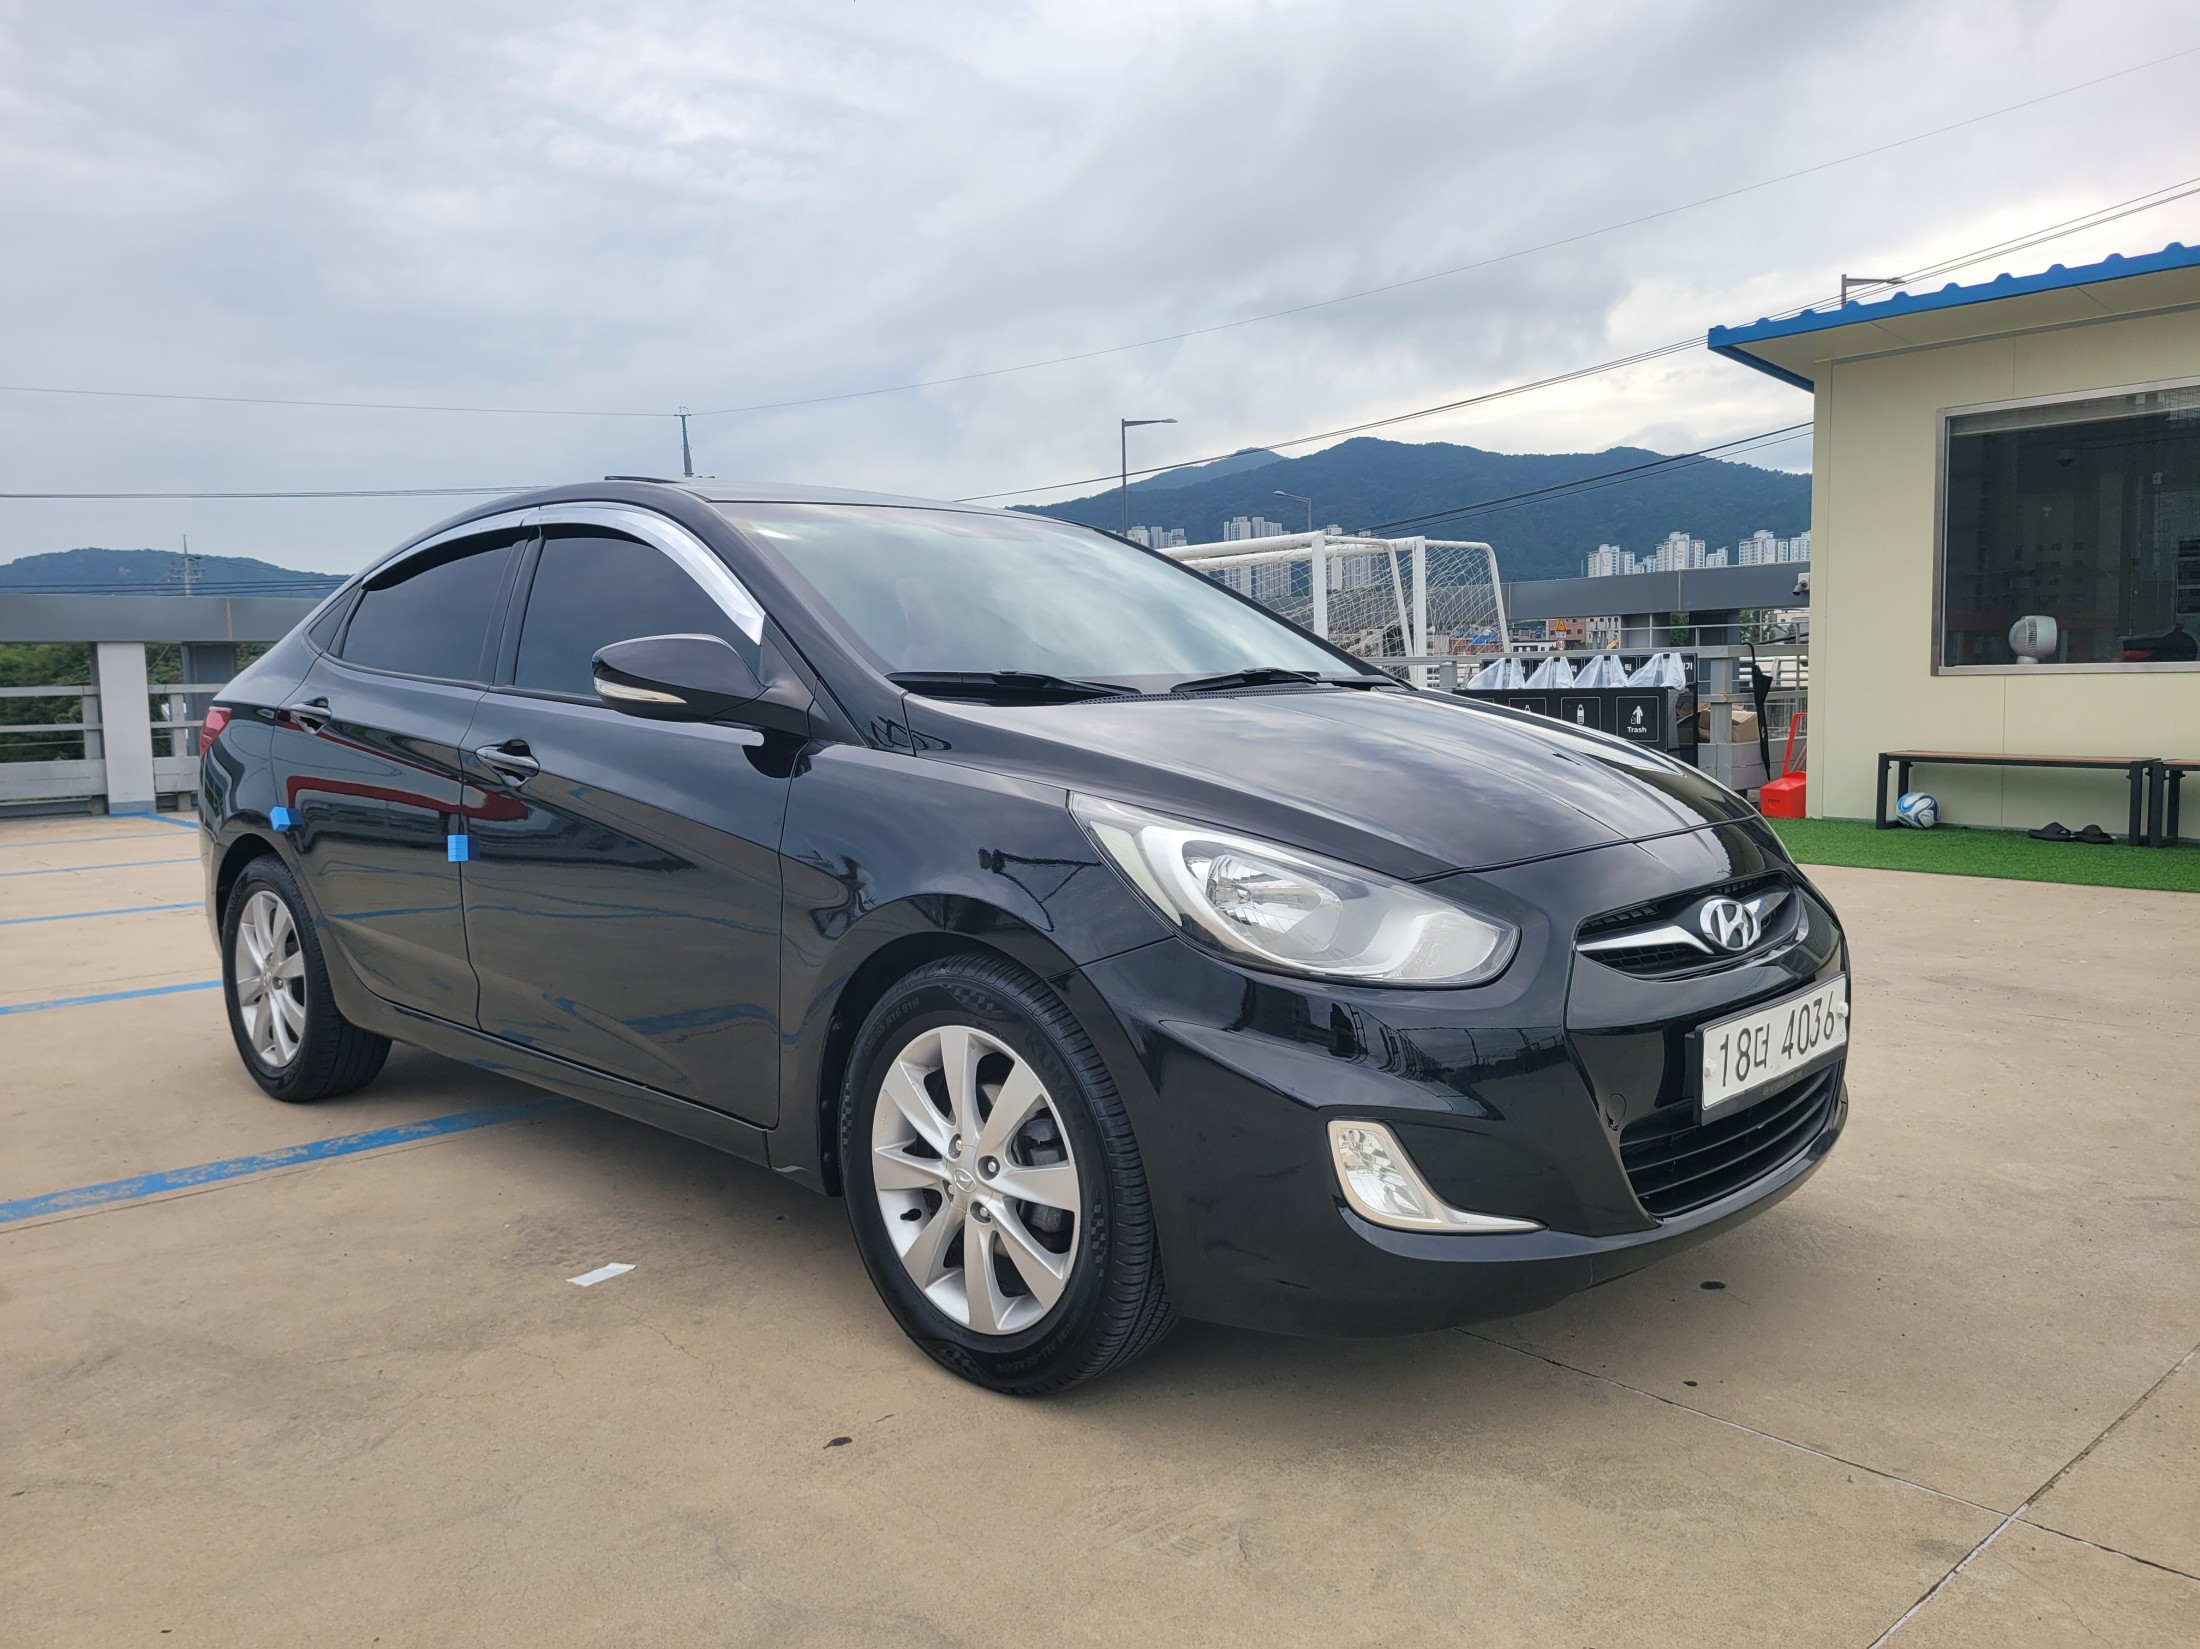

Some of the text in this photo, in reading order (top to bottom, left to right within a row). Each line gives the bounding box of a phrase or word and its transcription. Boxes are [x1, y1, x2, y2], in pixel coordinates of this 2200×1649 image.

[1627, 726, 1647, 734] Trash
[901, 996, 920, 1014] 91H
[1719, 990, 1835, 1087] 18더 4036
